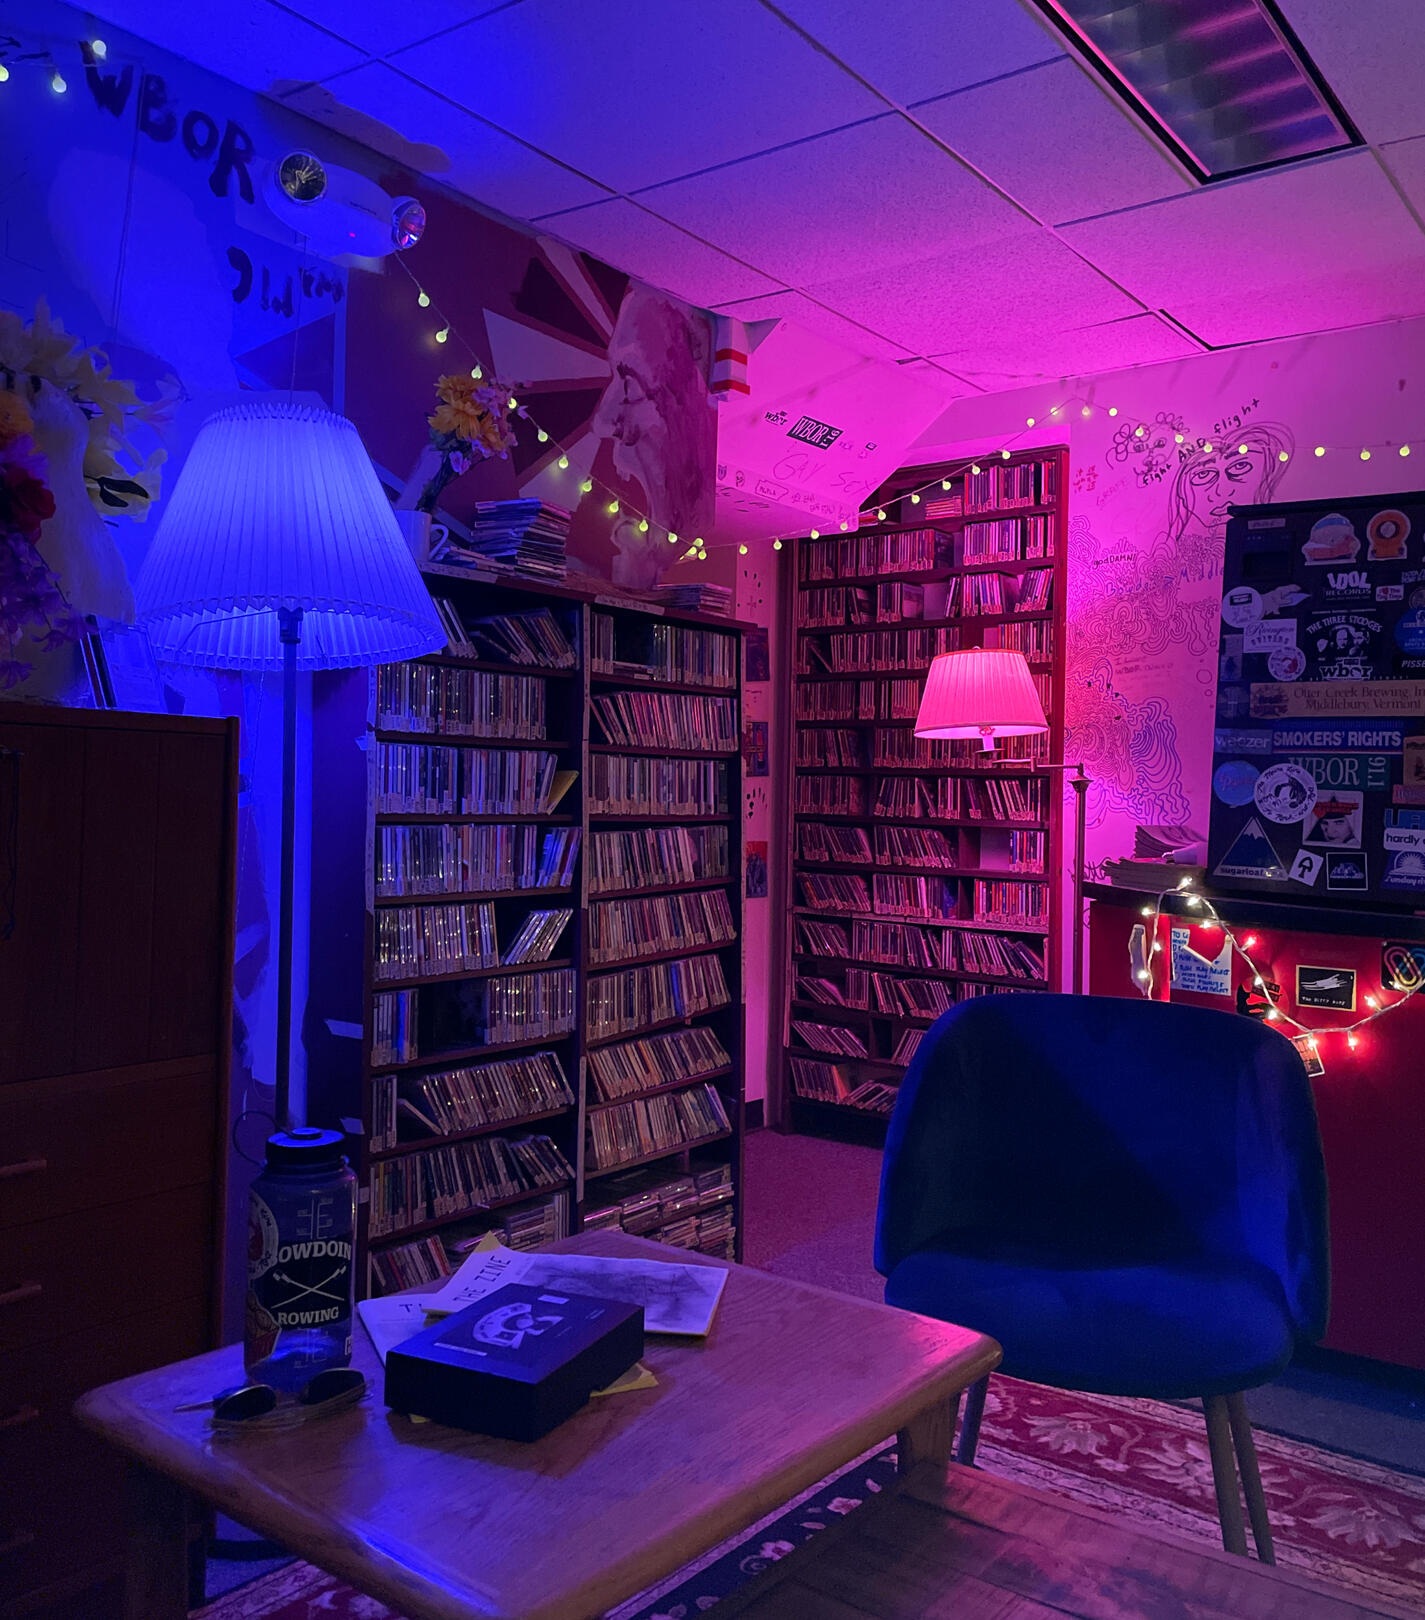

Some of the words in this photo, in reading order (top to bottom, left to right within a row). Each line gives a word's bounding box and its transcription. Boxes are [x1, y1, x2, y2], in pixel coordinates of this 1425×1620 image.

[79, 40, 255, 205] WBOR
[791, 418, 830, 443] WBOR
[1142, 463, 1172, 486] fight
[1178, 438, 1207, 463] AND
[1213, 398, 1260, 434] flight
[1326, 587, 1371, 597] RECORDS
[1306, 619, 1323, 634] THE
[1322, 614, 1346, 627] THREE
[1348, 614, 1384, 632] STOOGES
[1319, 663, 1373, 680] wbor
[1293, 687, 1321, 698] Otter
[1325, 686, 1357, 698] Creek
[1372, 698, 1422, 710] Vermont
[1215, 736, 1271, 749] weezer
[1273, 730, 1346, 747] SMOKERS'
[1348, 730, 1402, 747] RIGHTS
[1385, 832, 1419, 847] hardly
[278, 1239, 352, 1264] OWDOIN
[474, 1255, 512, 1283] ZINE
[277, 1306, 339, 1326] ROWING
